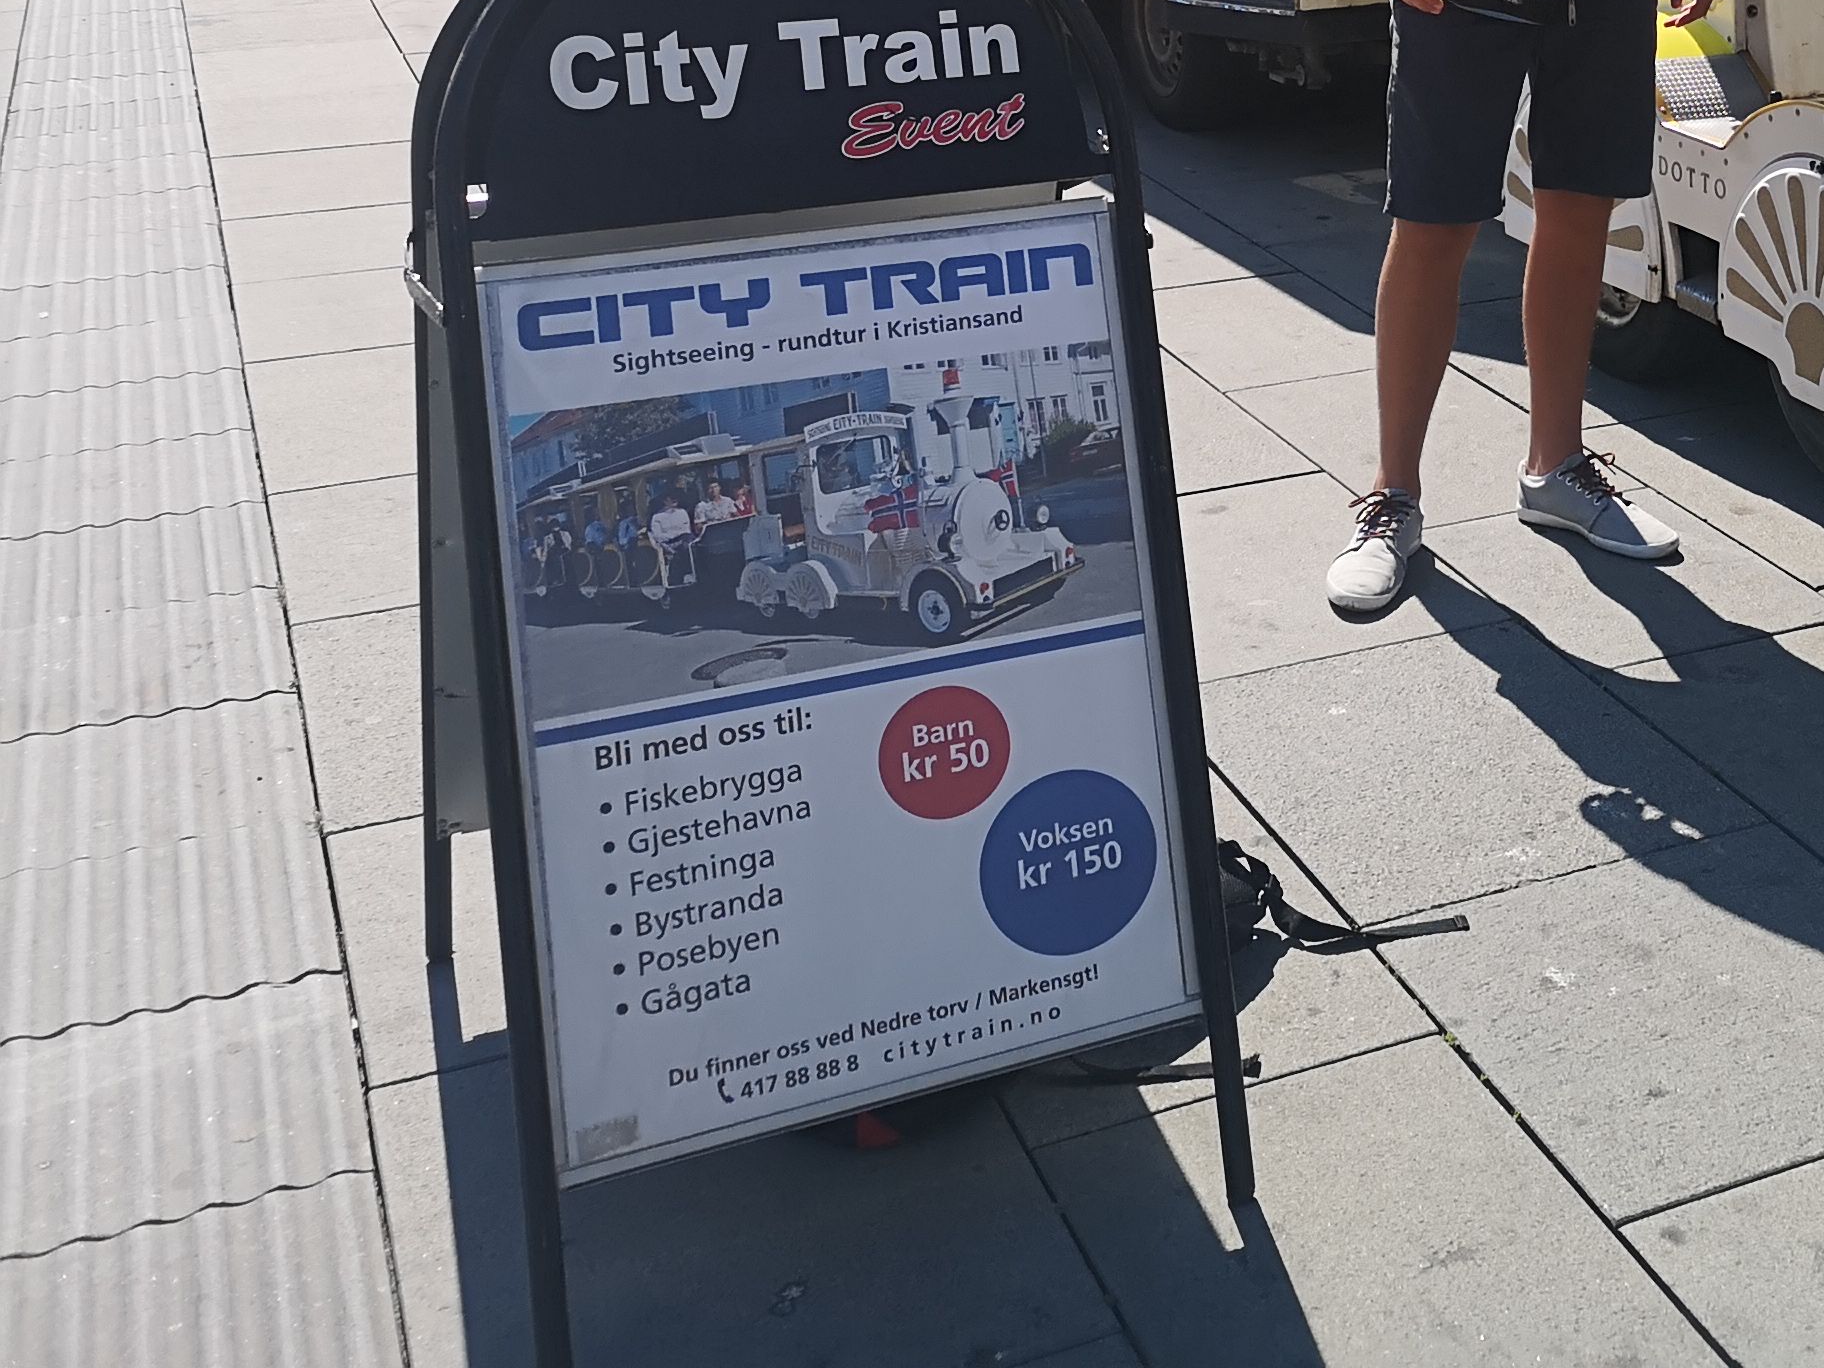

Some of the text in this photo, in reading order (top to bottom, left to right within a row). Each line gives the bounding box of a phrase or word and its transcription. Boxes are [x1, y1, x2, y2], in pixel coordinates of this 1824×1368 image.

[549, 9, 1021, 120] City Train
[841, 92, 1026, 159] Event
[1658, 155, 1727, 200] DOTTO
[516, 243, 1095, 352] CITY TRAIN
[612, 339, 756, 375] Sightseeing
[777, 326, 867, 353] rundtur
[873, 322, 881, 341] i
[886, 305, 1024, 339] Kristiansand
[595, 706, 813, 771] Bli med oss til:
[912, 719, 974, 747] Barn
[901, 738, 990, 783] kr 50
[624, 762, 803, 816] Fiskebrygga
[627, 799, 812, 858] Gjestehavna
[1018, 817, 1114, 852] Voksen
[630, 848, 776, 897] Festninga
[1017, 840, 1123, 890] kr 150
[635, 883, 784, 940] Bystranda
[638, 926, 780, 977] Posebyen
[641, 973, 752, 1015] Gågata
[668, 1066, 699, 1087] Du
[705, 1048, 771, 1078] finner
[776, 1038, 811, 1060] oss
[816, 1023, 855, 1049] ved
[860, 1011, 922, 1039] Nedre
[927, 999, 969, 1021] torv
[989, 963, 1100, 1006] Markensgt!
[740, 1073, 779, 1099] 417
[784, 1066, 811, 1089] 88
